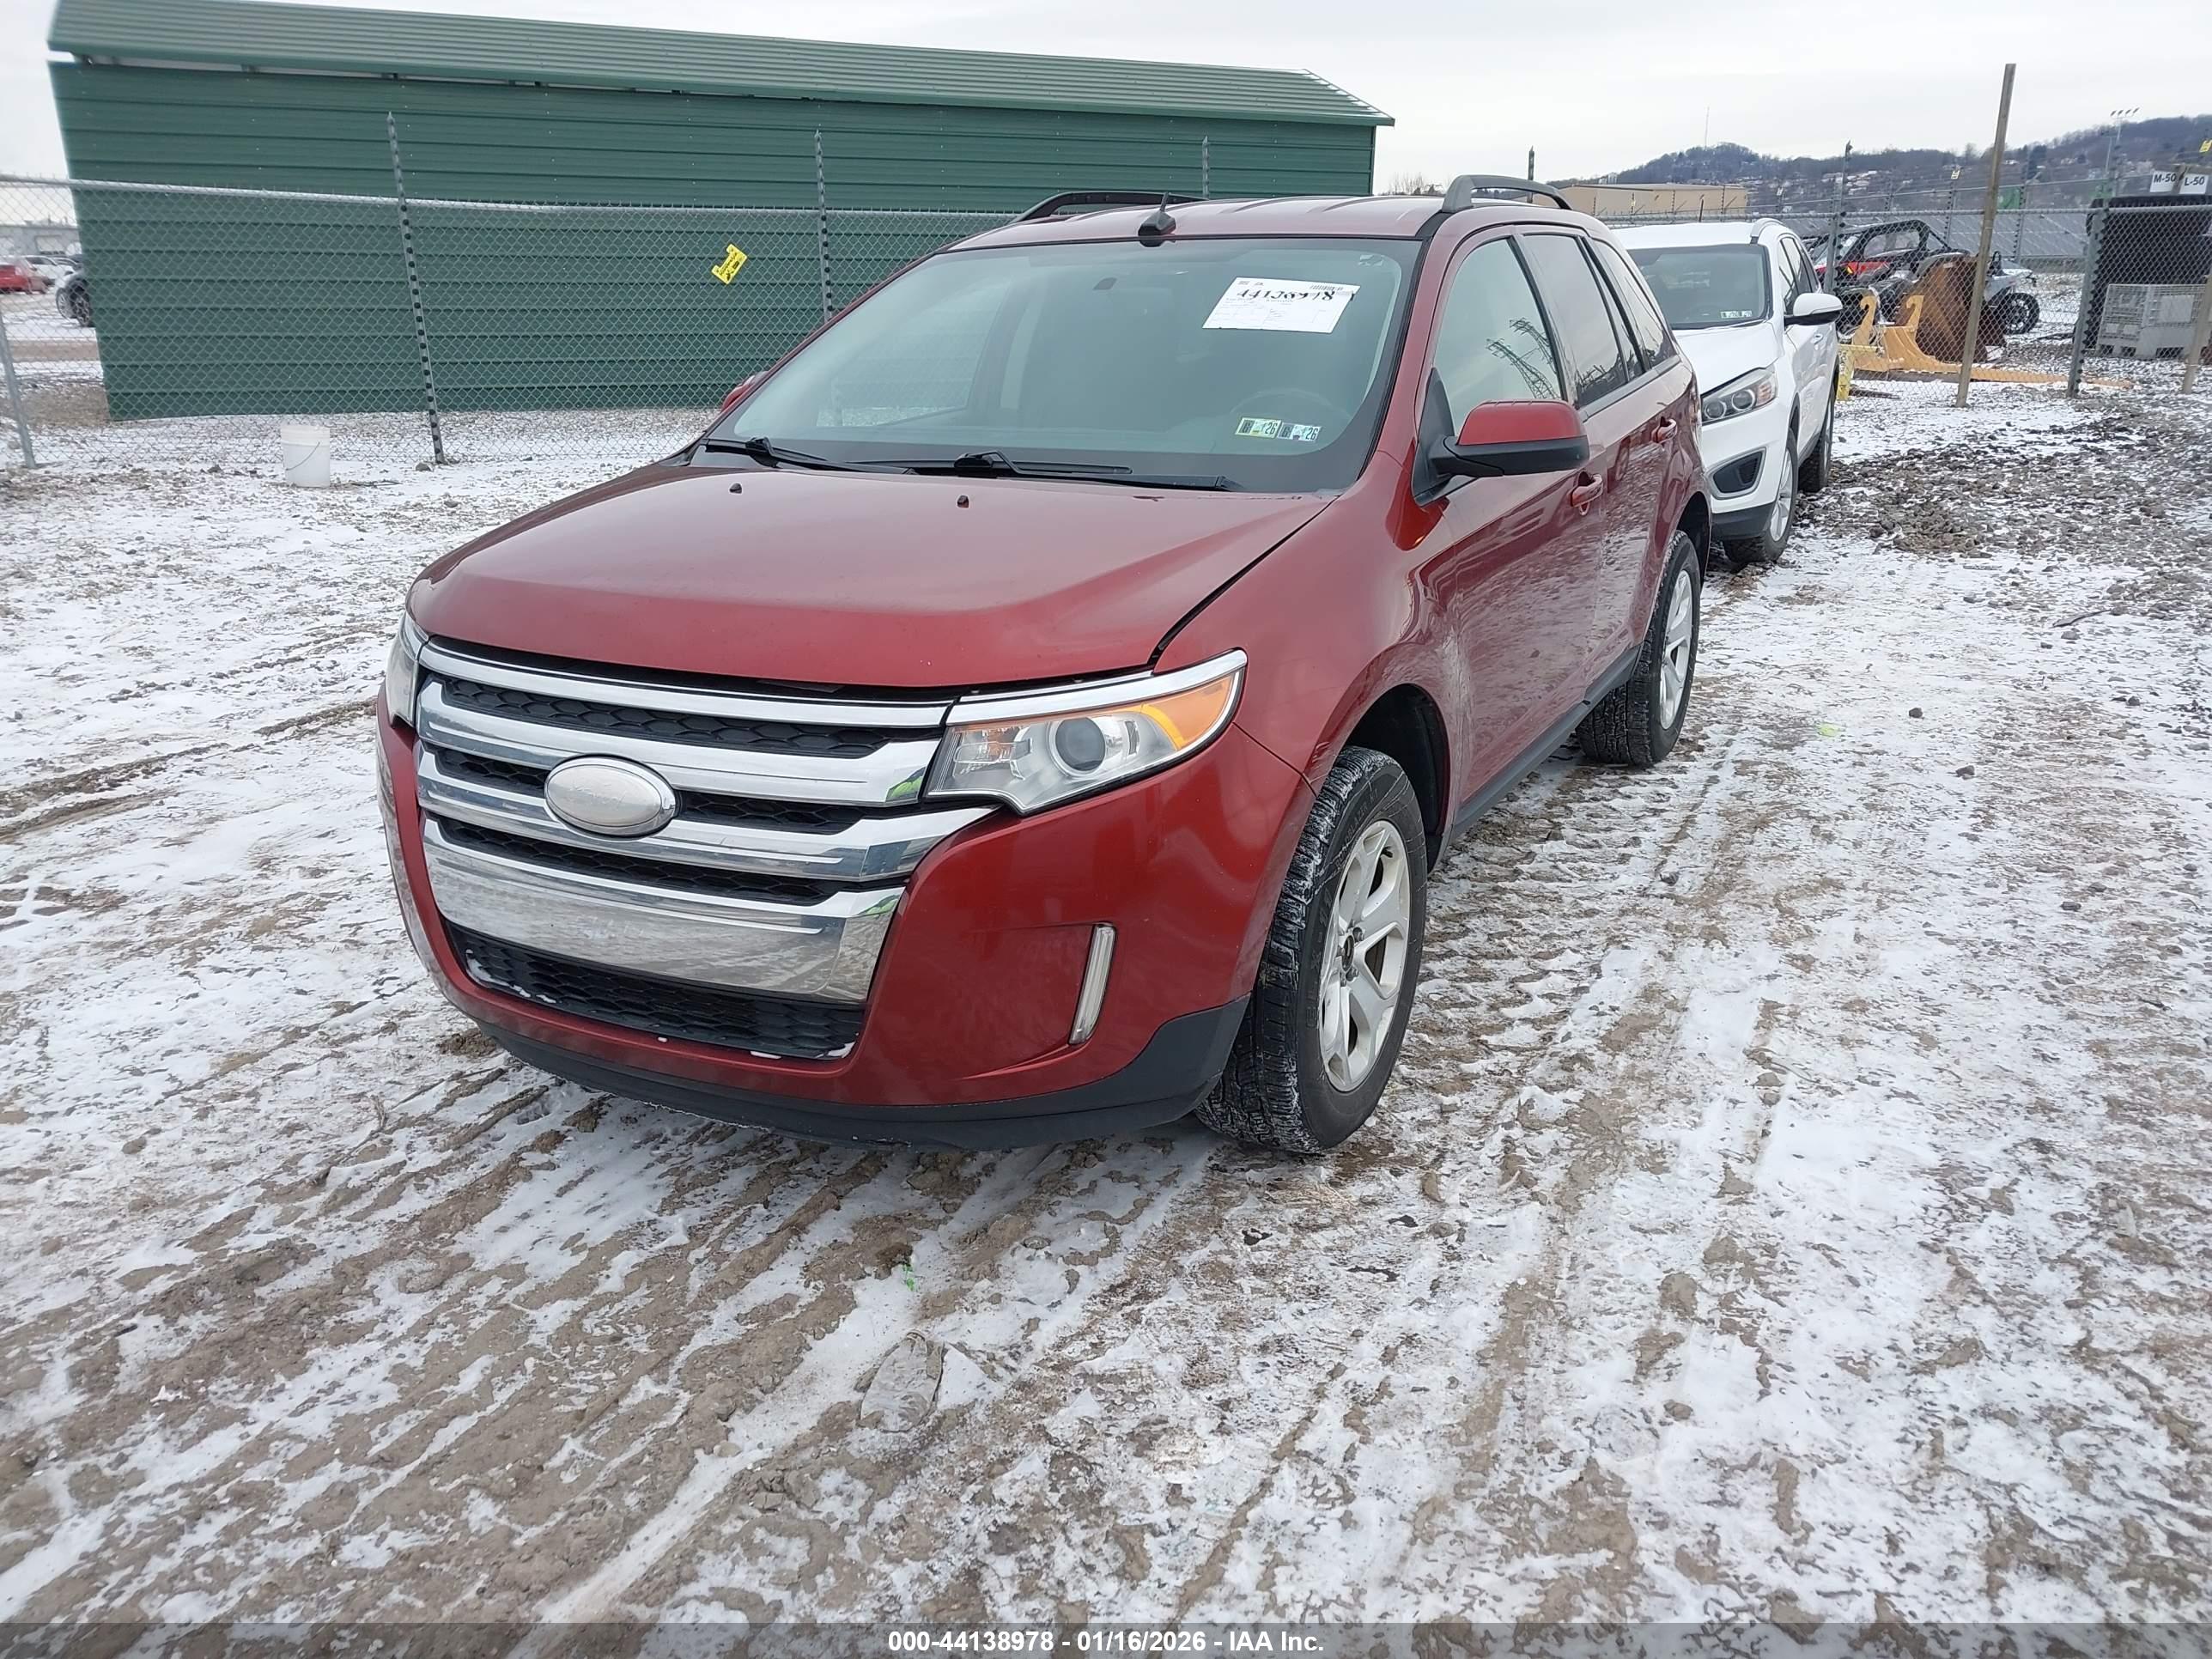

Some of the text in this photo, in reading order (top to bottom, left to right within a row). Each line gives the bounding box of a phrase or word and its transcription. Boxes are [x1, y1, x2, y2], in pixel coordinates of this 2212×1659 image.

[2154, 173, 2177, 183] M-50
[2185, 176, 2205, 186] L-50
[1265, 422, 1278, 434] 26
[1305, 427, 1319, 441] 26
